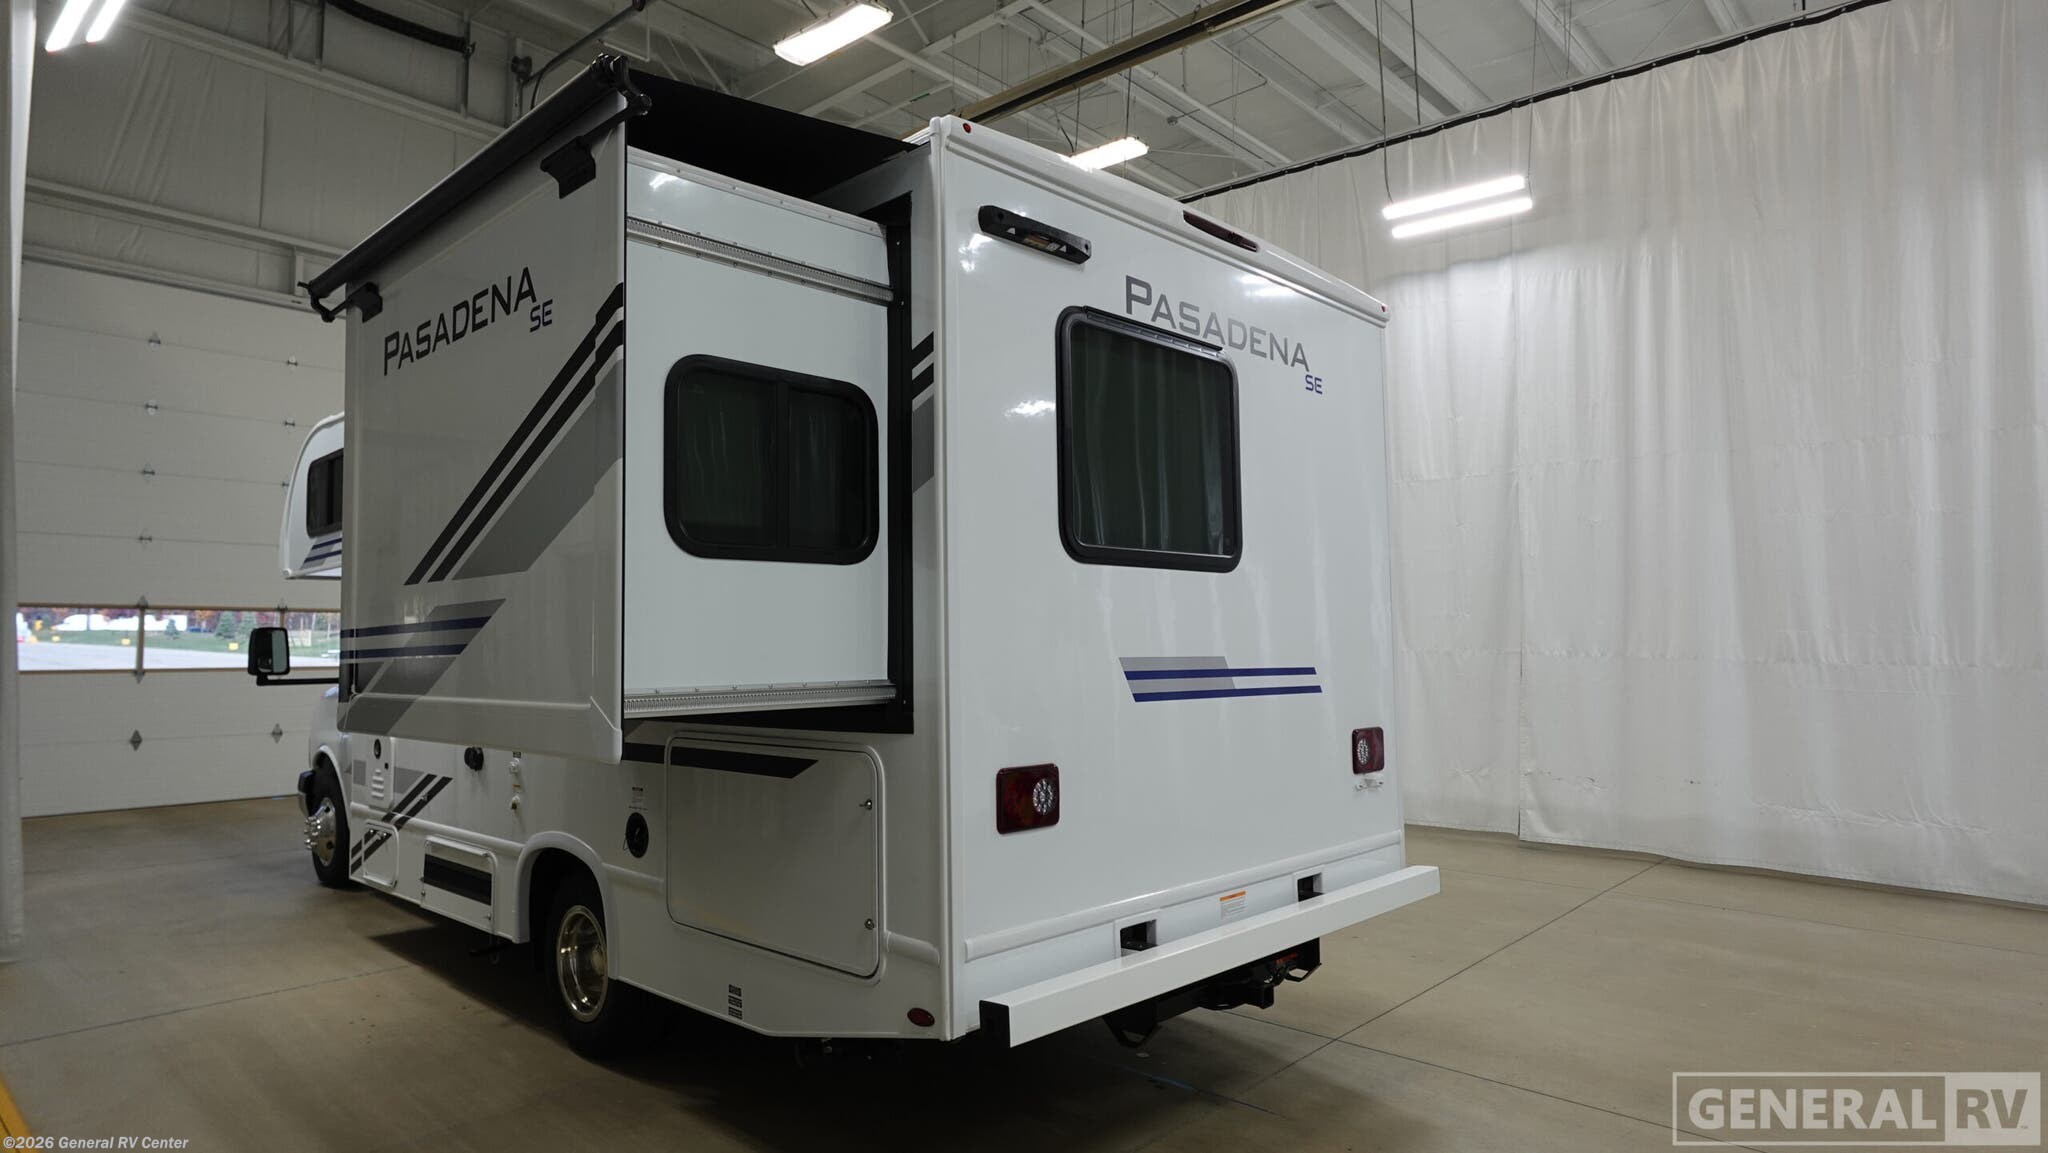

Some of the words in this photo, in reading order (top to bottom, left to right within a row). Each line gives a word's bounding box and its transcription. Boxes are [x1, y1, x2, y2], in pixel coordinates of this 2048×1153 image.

[384, 266, 537, 376] PASADENA
[529, 299, 553, 333] SE
[1125, 275, 1310, 372] PASADENA
[1305, 374, 1323, 395] SE
